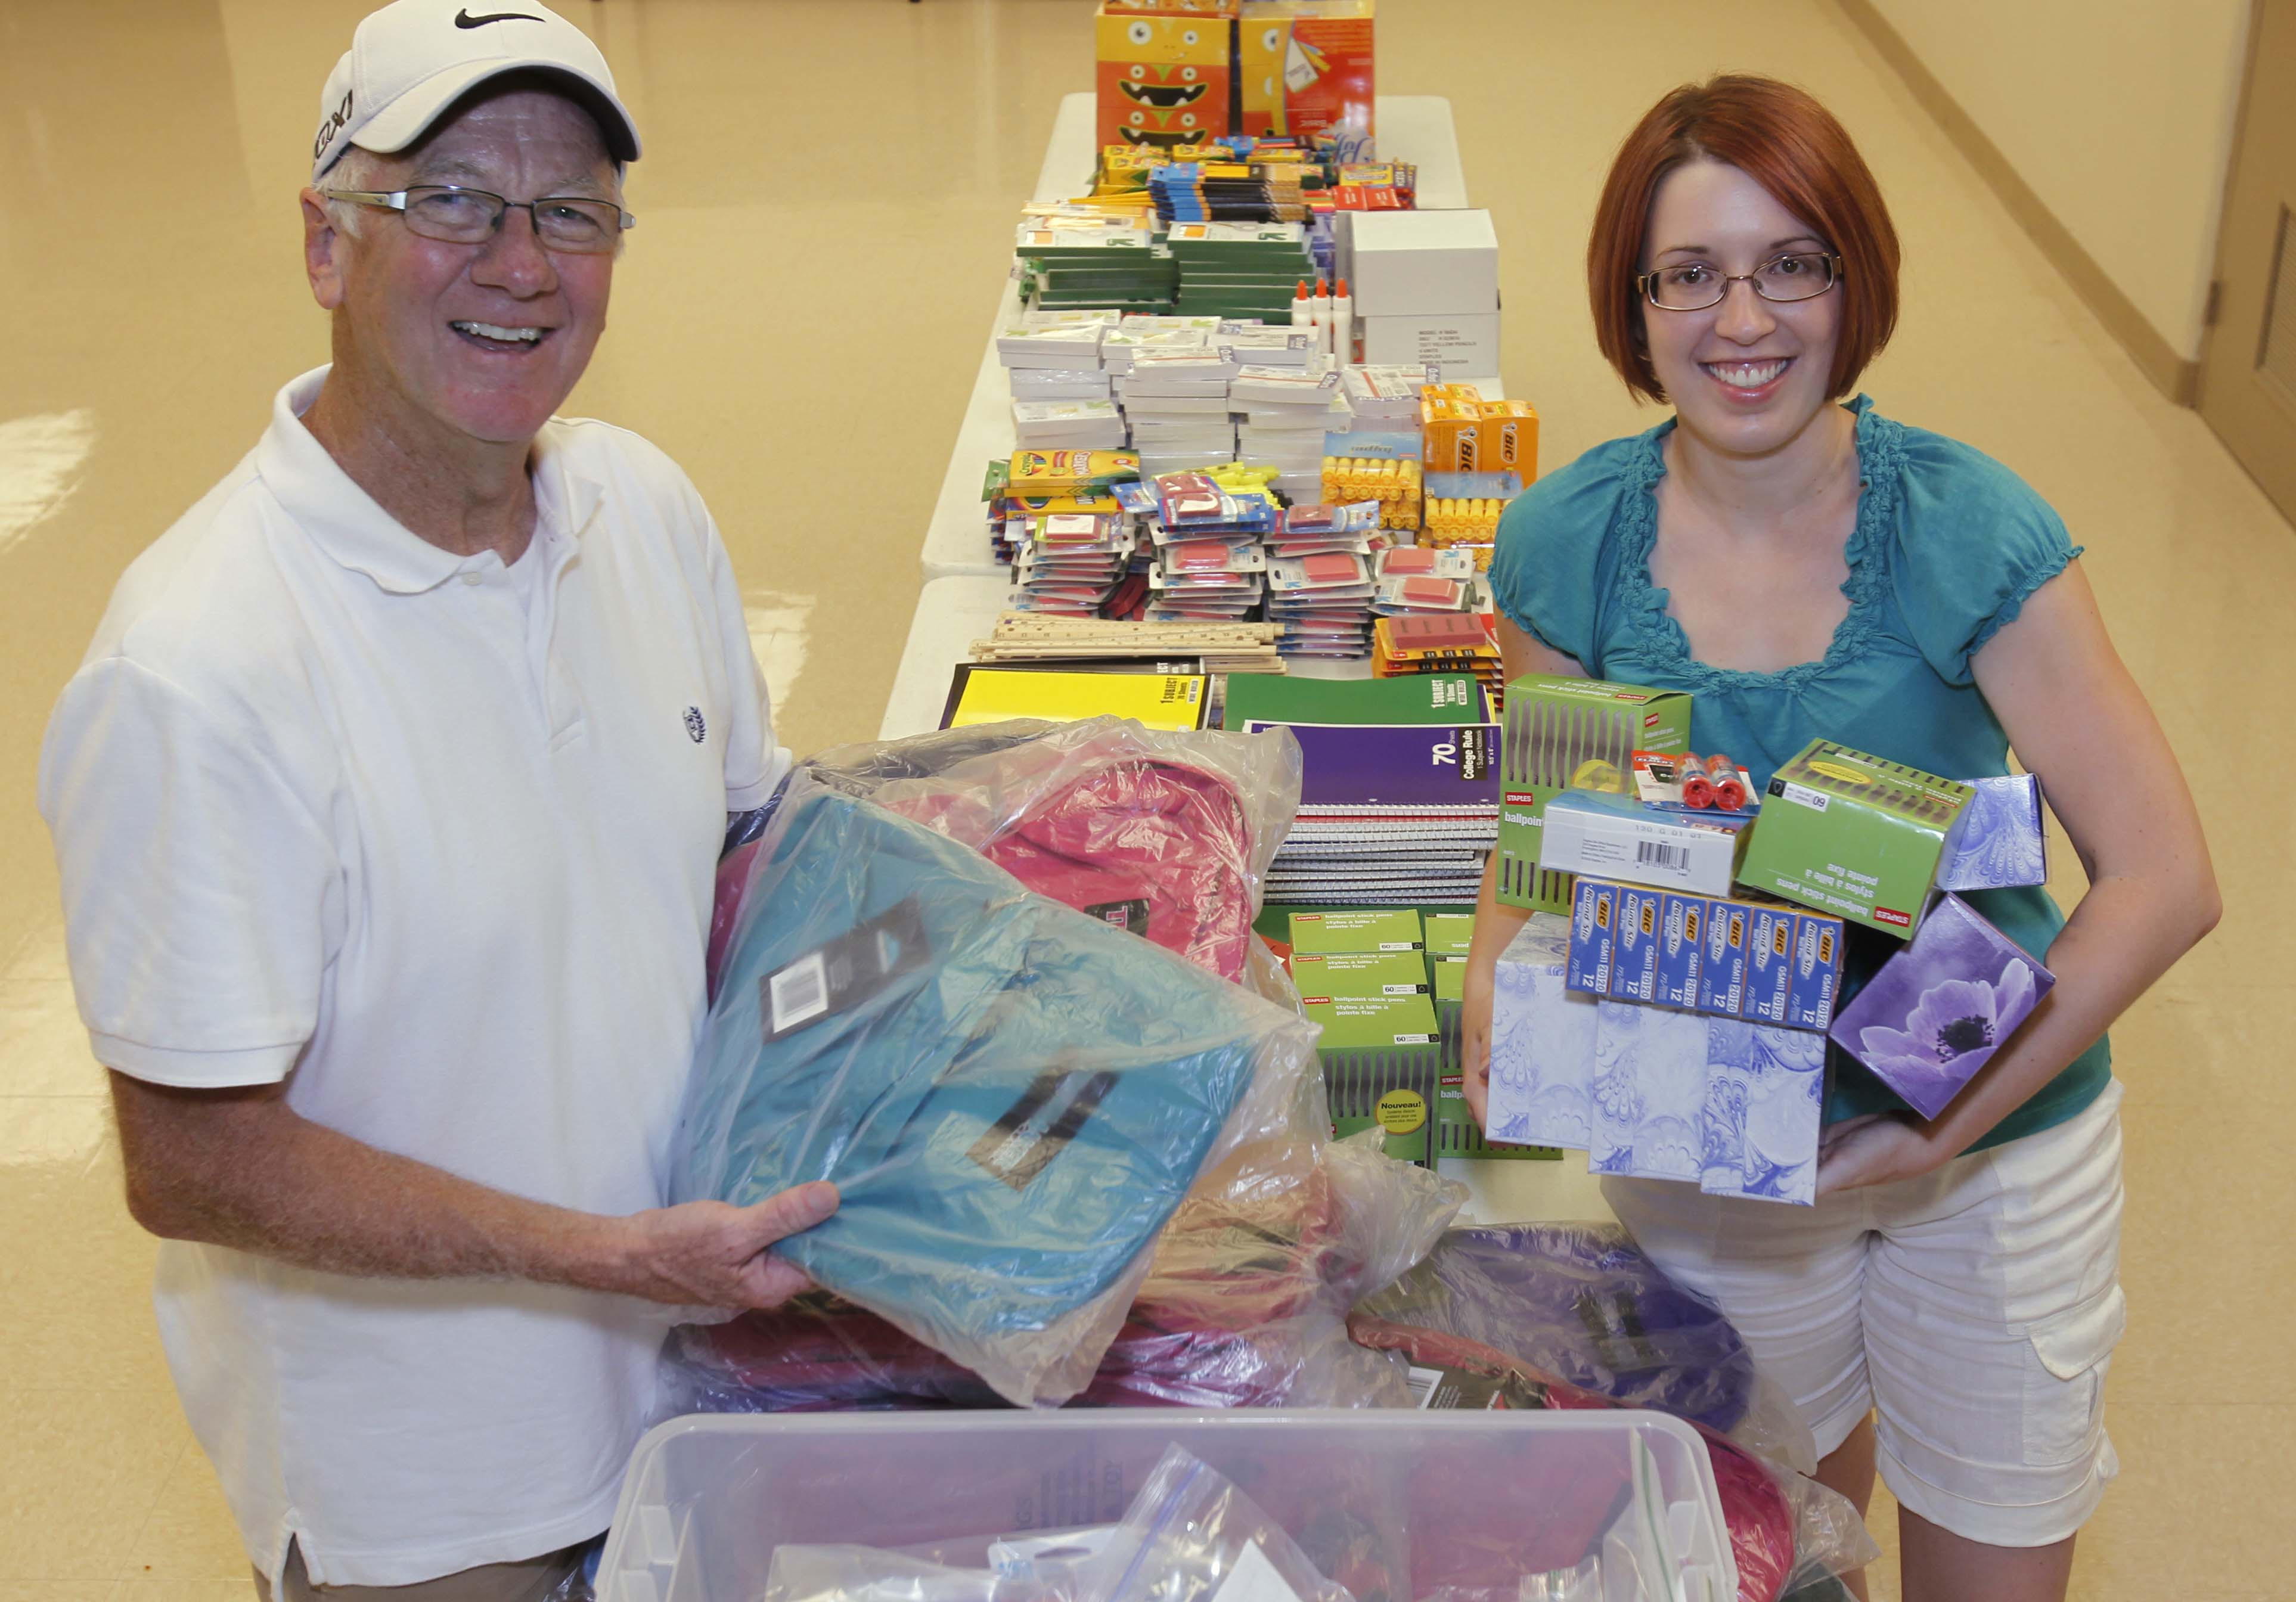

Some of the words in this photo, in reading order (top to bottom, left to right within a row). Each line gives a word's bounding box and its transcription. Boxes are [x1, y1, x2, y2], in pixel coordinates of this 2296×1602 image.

[1504, 434, 1514, 461] BIC
[1163, 677, 1178, 699] SUBJECT
[1432, 679, 1445, 703] SUBJECT
[1446, 683, 1456, 697] Sheets
[1462, 729, 1473, 749] Rule
[1432, 743, 1456, 765] 70
[1463, 749, 1476, 780] College
[1476, 750, 1484, 766] Subject
[1813, 795, 1826, 808] 60
[1813, 872, 1835, 886] bille
[1827, 863, 1846, 877] fixe
[1847, 870, 1879, 886] pointe
[1776, 877, 1800, 892] pens
[1801, 886, 1826, 901] stick
[1845, 882, 1875, 899] stylos
[1584, 888, 1594, 921] Round
[1599, 901, 1609, 926] BIC
[1628, 895, 1638, 928] Round
[1826, 895, 1869, 917] ballpoint
[1643, 907, 1653, 933] BIC
[1672, 901, 1682, 935] Round
[1686, 914, 1696, 940] BIC
[1716, 908, 1726, 940] Round
[1875, 911, 1909, 924] STAPLES
[1581, 924, 1590, 939] Stic
[1625, 932, 1634, 946] Stic
[1730, 920, 1740, 946] BIC
[1760, 915, 1770, 949] Round
[1775, 927, 1785, 954] BIC
[1805, 923, 1816, 956] Round
[1600, 939, 1610, 963] GSM11
[1669, 939, 1678, 952] Stic
[1712, 944, 1722, 958] Stic
[1820, 934, 1830, 961] BIC
[1643, 945, 1655, 970] GSM11
[1688, 952, 1699, 977] GSM11
[1757, 952, 1766, 967] Stic
[1802, 959, 1812, 974] Stic
[1583, 974, 1595, 988] 12
[1596, 965, 1608, 992] 20120
[1732, 958, 1743, 983] GSM11
[1776, 965, 1787, 991] GSM11
[1627, 980, 1640, 995] 12
[1640, 971, 1653, 999] 20120
[1670, 988, 1683, 1002] 12
[1684, 978, 1697, 1007] 20120
[1820, 973, 1832, 999] GSM11
[1713, 994, 1727, 1008] 12
[1727, 984, 1740, 1012] 20120
[1758, 1001, 1771, 1016] 12
[1772, 992, 1786, 1020] 20120
[1802, 1010, 1816, 1023] 12
[1816, 999, 1830, 1028] 20120
[1381, 1101, 1421, 1109] Nouveau!
[1441, 1090, 1465, 1100] ballp
